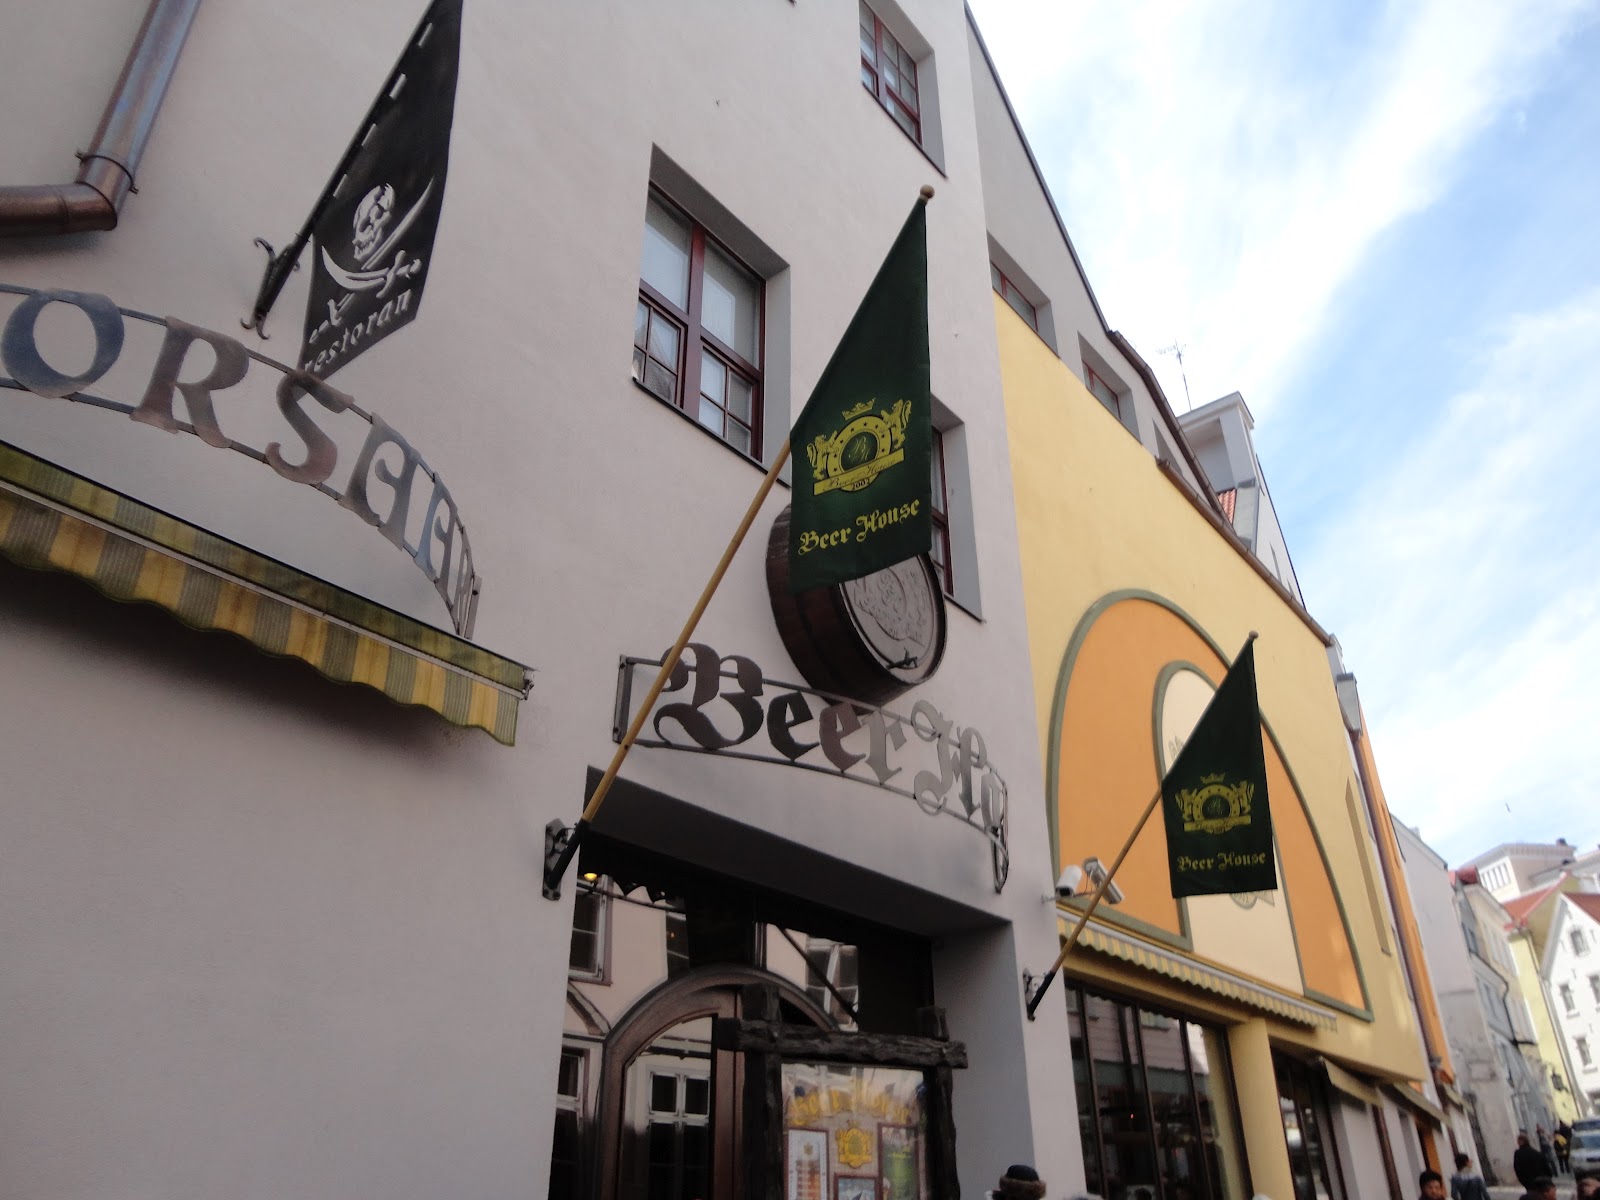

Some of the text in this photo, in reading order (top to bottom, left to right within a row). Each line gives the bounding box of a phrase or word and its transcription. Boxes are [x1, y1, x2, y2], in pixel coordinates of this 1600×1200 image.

[304, 288, 411, 373] restoran
[798, 499, 920, 555] Beer House
[653, 642, 909, 785] Beer
[1177, 851, 1266, 872] Beer House
